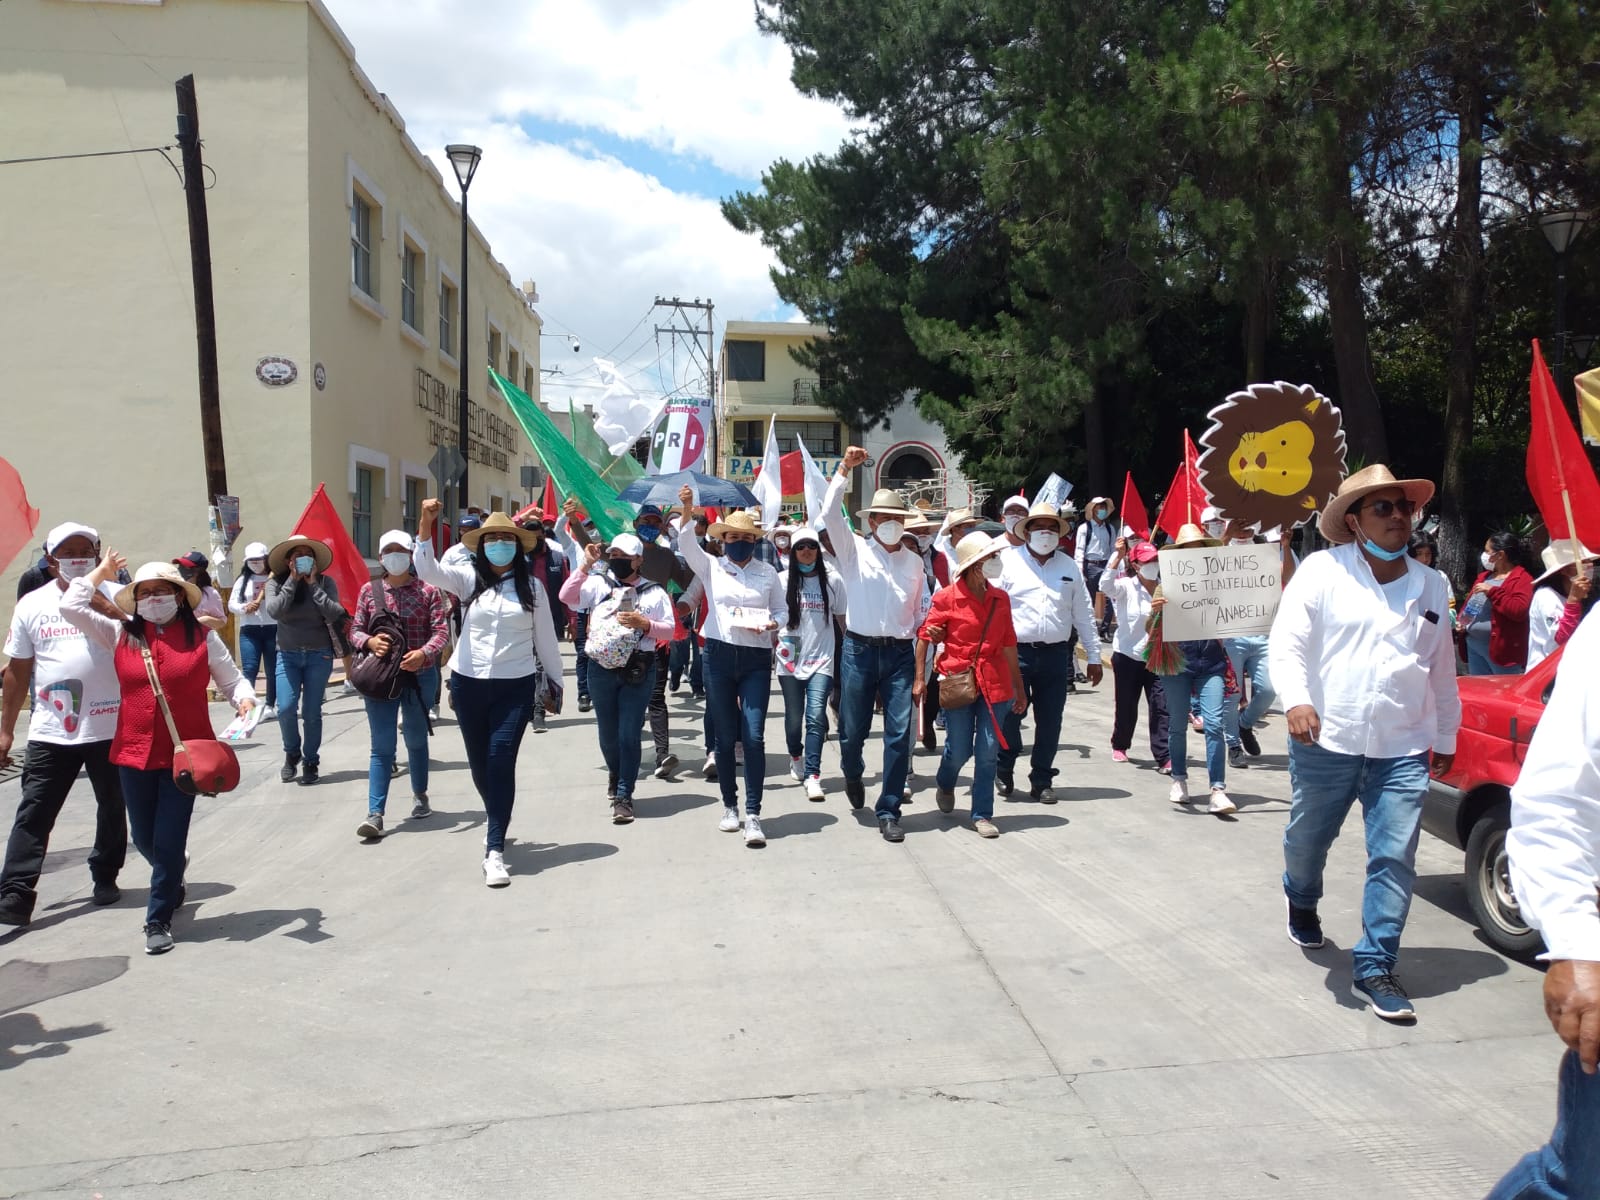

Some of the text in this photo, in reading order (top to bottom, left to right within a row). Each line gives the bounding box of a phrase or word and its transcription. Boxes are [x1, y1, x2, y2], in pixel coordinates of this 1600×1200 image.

[654, 432, 697, 450] PRI
[1169, 555, 1259, 576] LOS JOVENES
[1182, 582, 1198, 593] DE
[1181, 597, 1220, 610] CONTIGO
[1216, 604, 1269, 625] ANABELL
